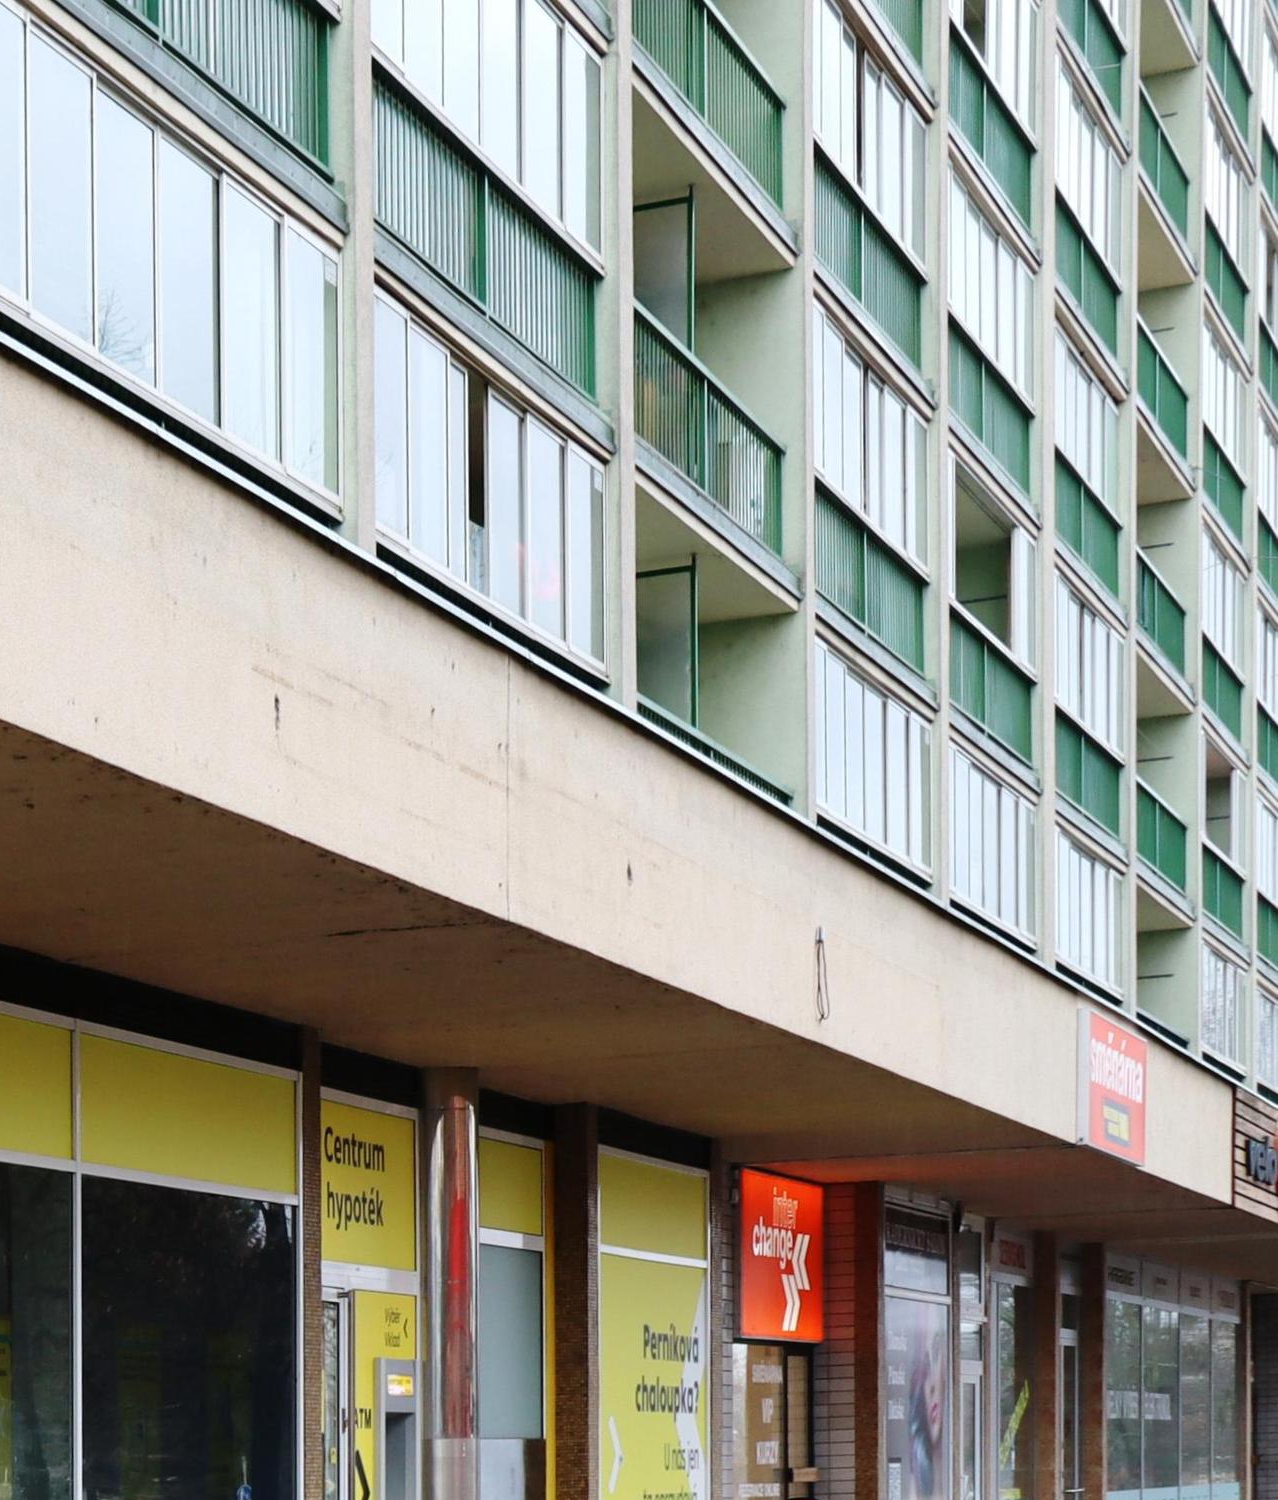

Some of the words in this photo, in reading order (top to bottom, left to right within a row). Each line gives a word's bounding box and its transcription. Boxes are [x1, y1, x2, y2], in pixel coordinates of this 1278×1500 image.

[1091, 1031, 1144, 1104] směnárna
[324, 1126, 386, 1172] Centrum
[326, 1181, 384, 1231] hypoték
[772, 1186, 799, 1230] inter
[752, 1215, 794, 1270] change
[643, 1323, 699, 1363] Perníková
[635, 1375, 699, 1423] chaloupka?
[663, 1442, 670, 1471] U
[671, 1441, 686, 1471] nás
[686, 1440, 699, 1478] jen
